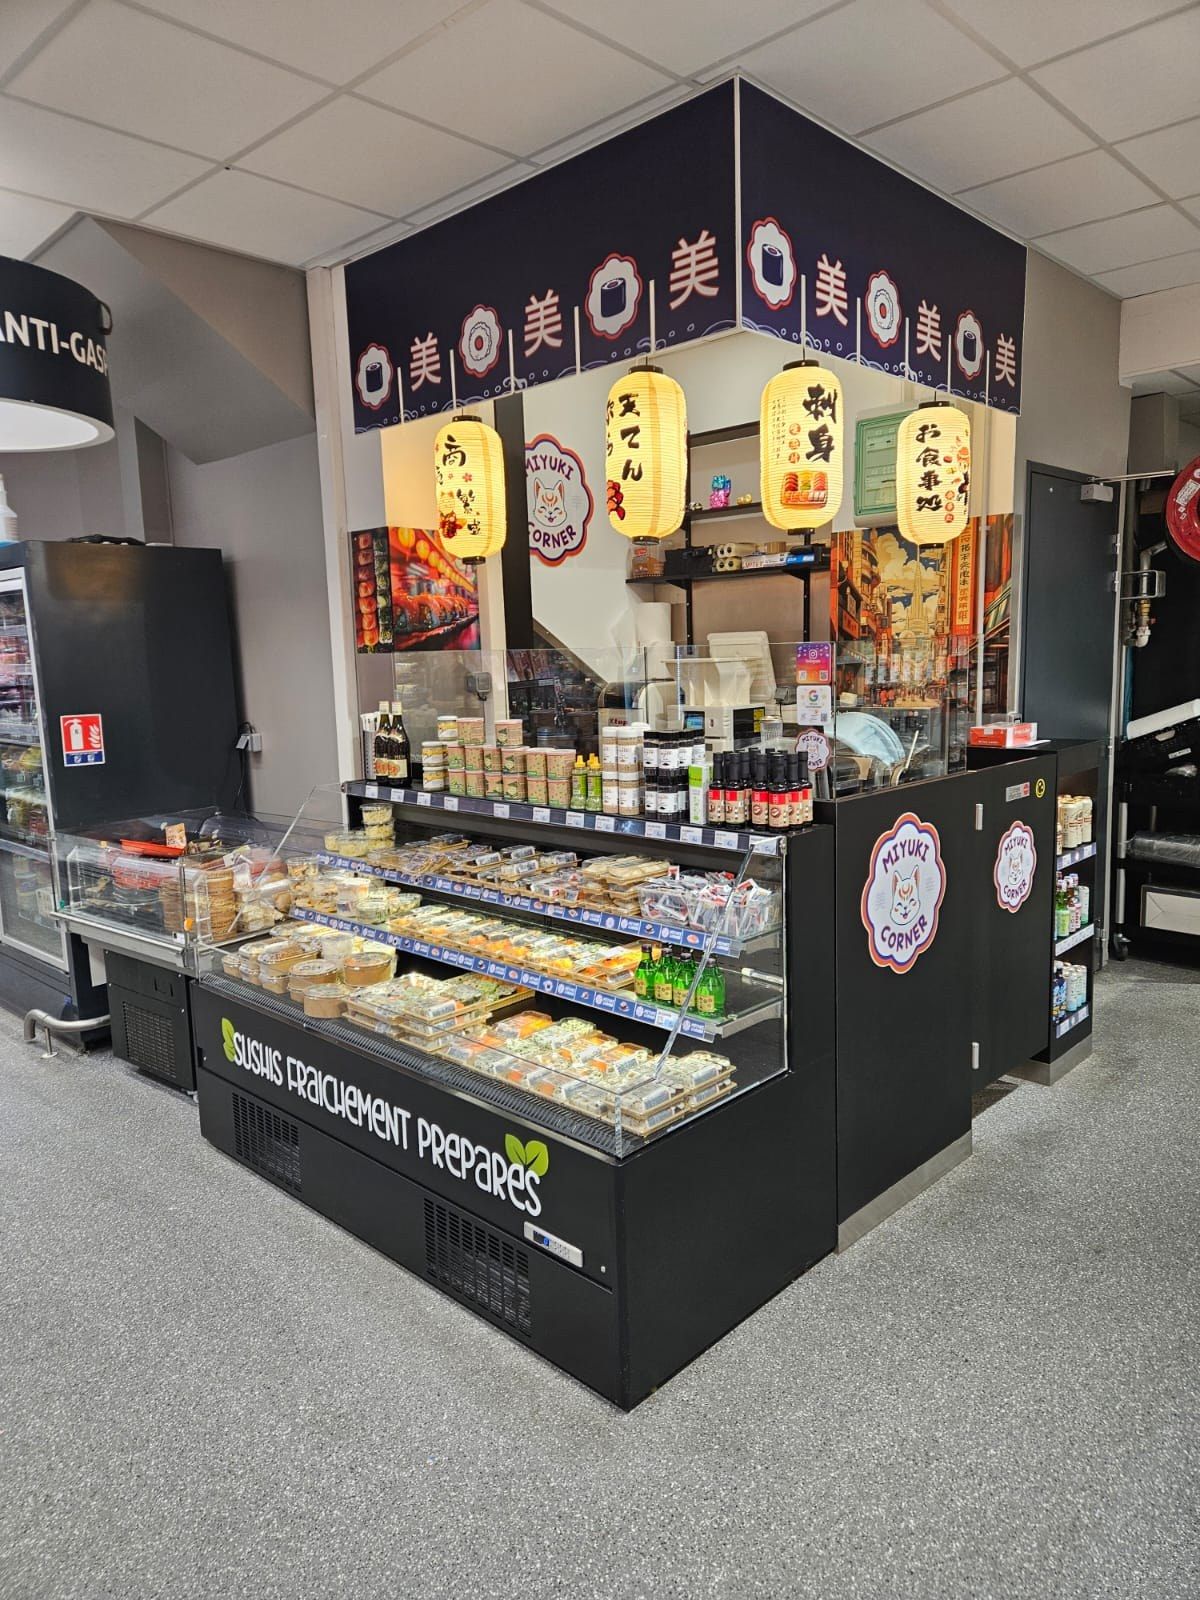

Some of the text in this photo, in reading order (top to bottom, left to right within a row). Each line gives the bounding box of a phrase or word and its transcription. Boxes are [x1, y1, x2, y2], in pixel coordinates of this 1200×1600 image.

[669, 229, 720, 310] 美
[816, 253, 848, 327] 美
[524, 289, 563, 358] 美
[916, 300, 942, 362] 美
[409, 332, 441, 391] 美
[995, 333, 1016, 387] 美
[882, 838, 929, 874] MIYUKI
[1004, 836, 1028, 856] MIYUKI
[1003, 879, 1028, 900] CORNER
[881, 914, 928, 952] CORNER
[233, 1032, 283, 1087] SUSHIS
